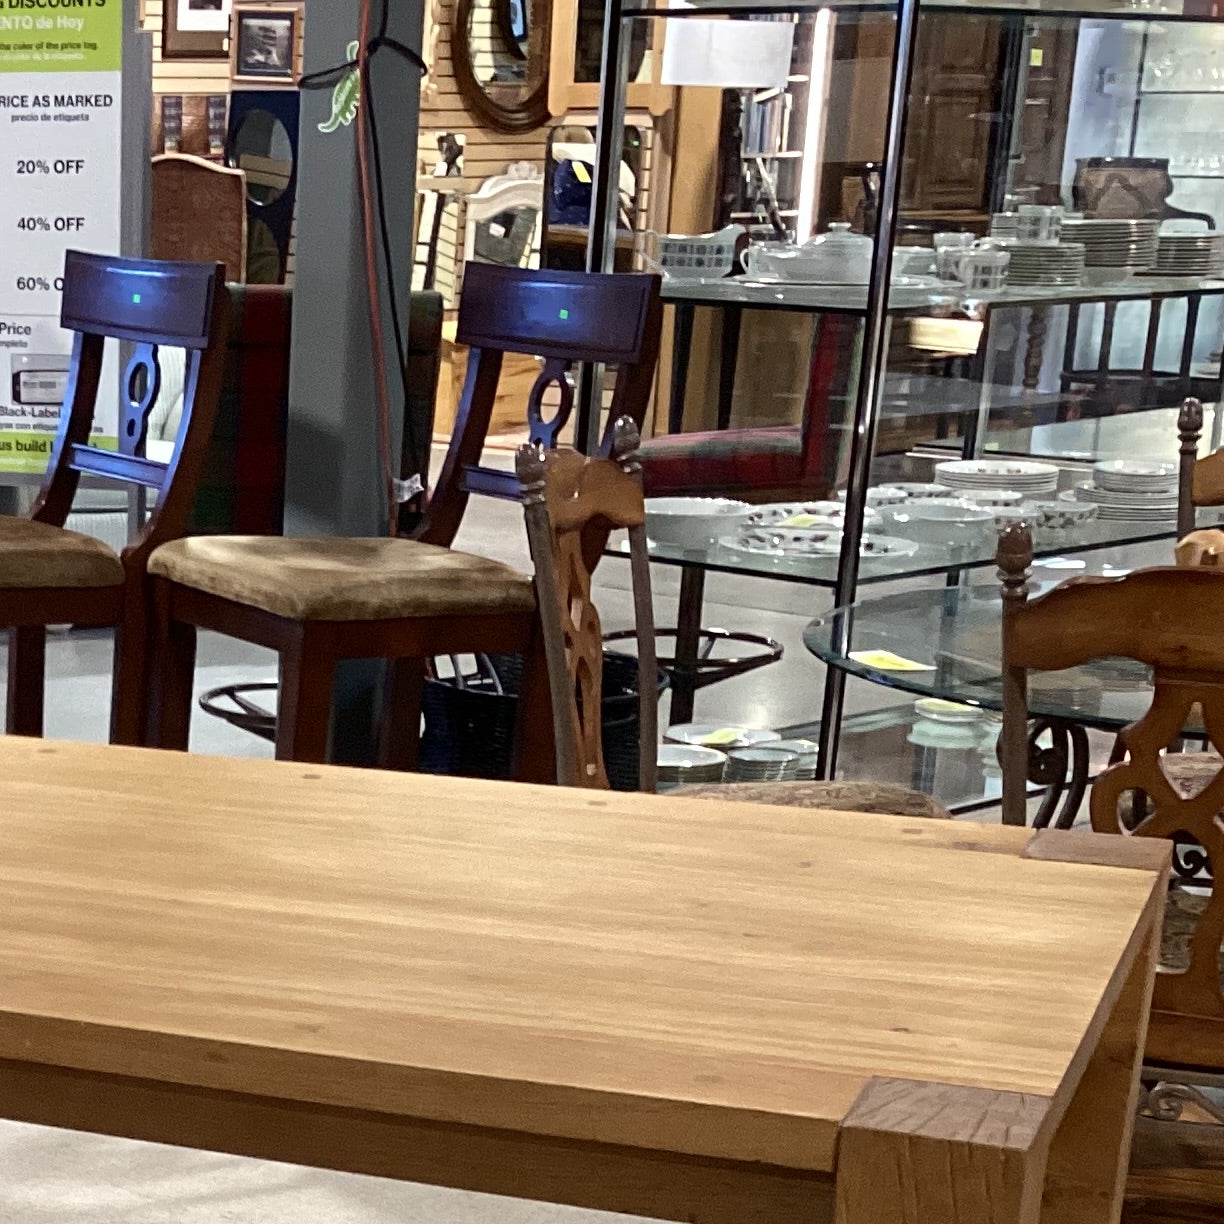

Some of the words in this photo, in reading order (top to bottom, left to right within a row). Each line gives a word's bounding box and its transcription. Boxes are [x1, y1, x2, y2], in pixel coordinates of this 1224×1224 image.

[36, 16, 53, 30] de
[56, 16, 84, 31] Hoy
[60, 42, 81, 51] price
[32, 95, 50, 107] AS
[54, 94, 113, 107] MARKED
[11, 113, 38, 122] precio
[40, 113, 51, 121] de
[53, 113, 89, 123] etiqueta
[16, 160, 50, 174] 20%
[54, 160, 85, 173] OFF
[17, 217, 50, 231] 40%
[54, 217, 85, 230] OFF
[16, 277, 50, 291] 60%
[15, 439, 47, 452] build
